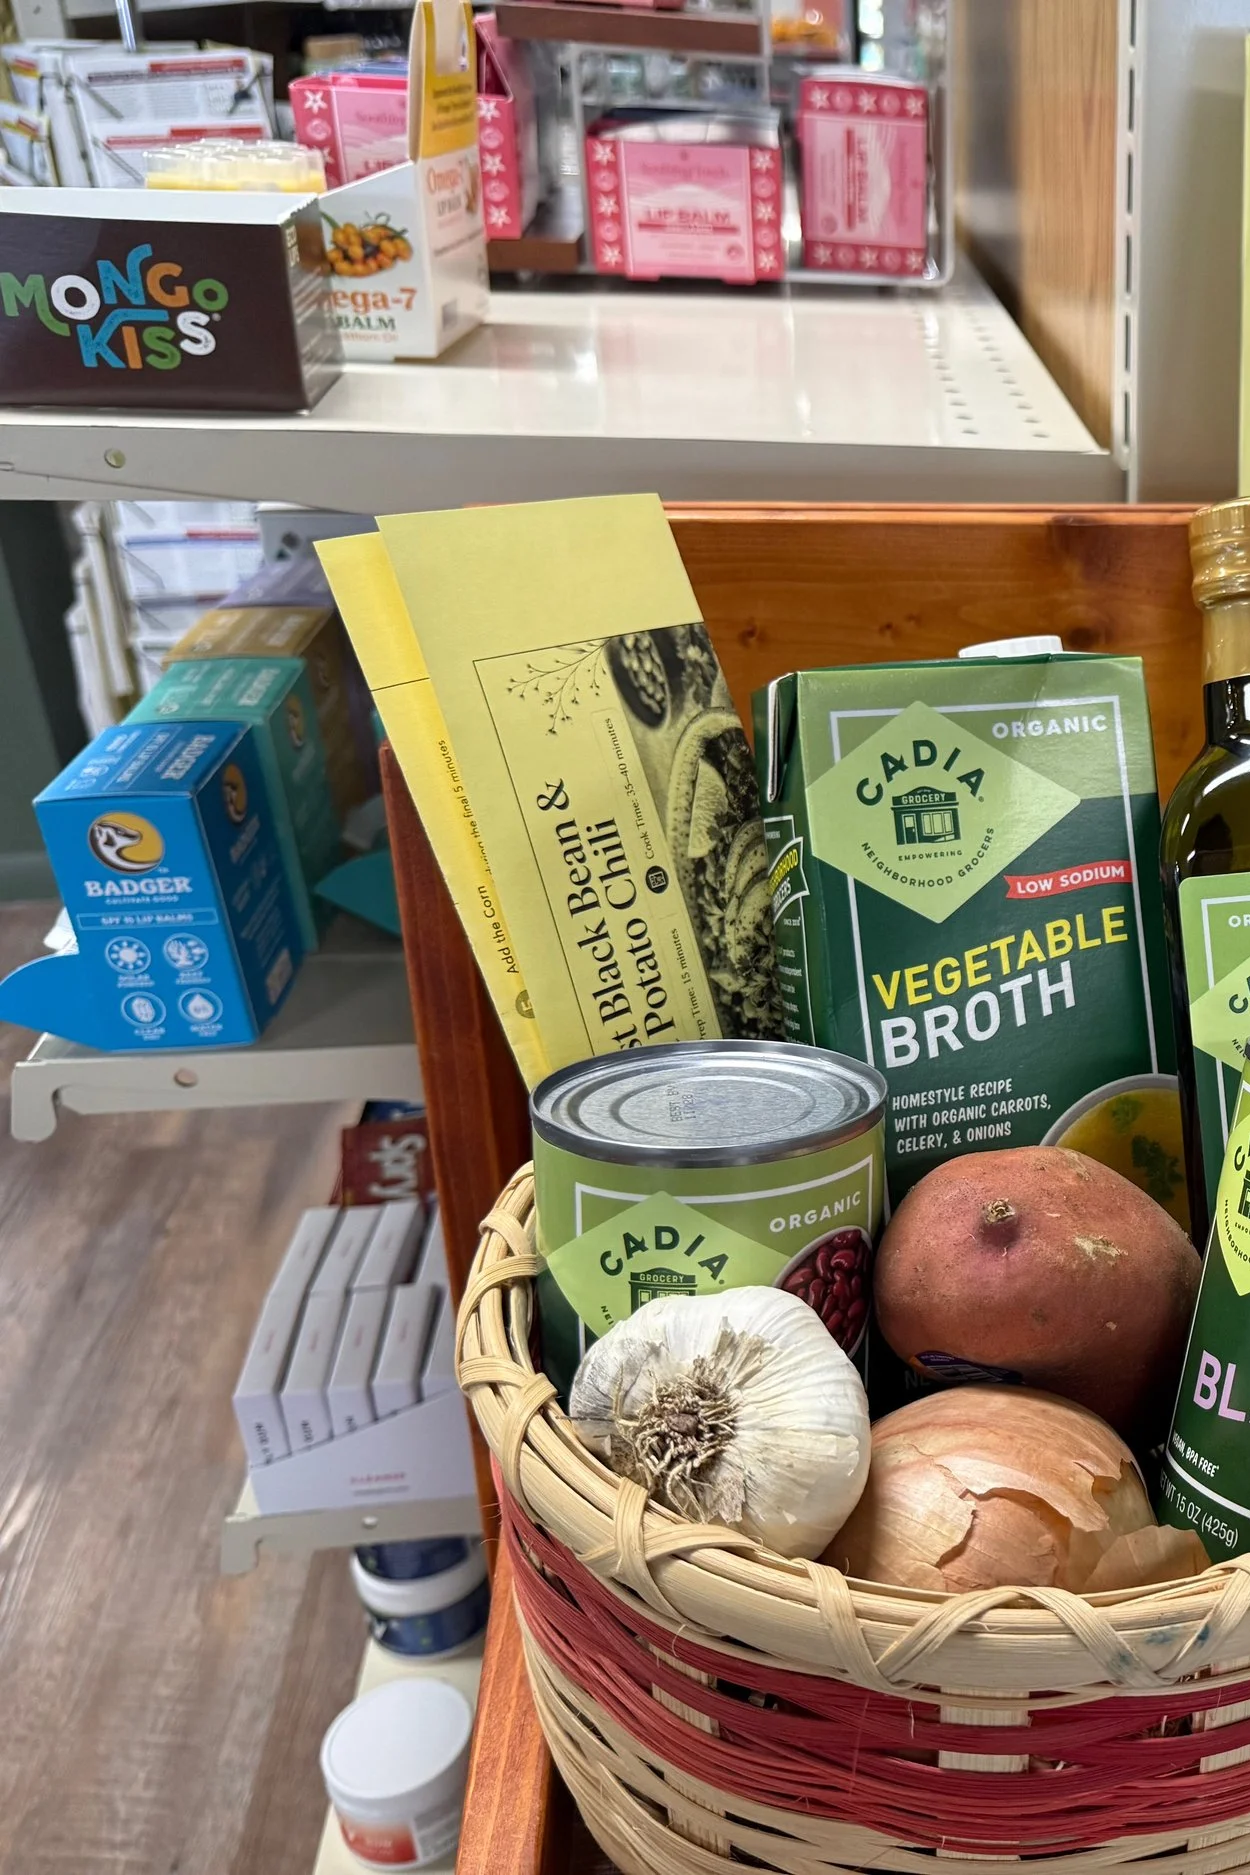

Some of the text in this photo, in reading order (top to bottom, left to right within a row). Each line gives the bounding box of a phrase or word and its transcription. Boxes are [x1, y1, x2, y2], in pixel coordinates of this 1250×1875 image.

[0, 243, 228, 337] MONGO
[76, 308, 217, 370] KISS
[603, 717, 626, 761] minutes
[992, 714, 1109, 740] ORGANIC
[438, 740, 478, 838] the final minutes
[856, 738, 986, 807] CADIA
[536, 777, 570, 812] &
[630, 797, 647, 831] Time:
[901, 792, 946, 806] GROCERY
[585, 816, 638, 910] Chili
[637, 833, 656, 860] Cook
[861, 841, 954, 888] NEIGHBORHOOD
[958, 826, 995, 879] GROCERS
[898, 849, 963, 862] EMPOWERING
[83, 876, 193, 898] BADGER
[555, 817, 602, 918] Bean
[1016, 864, 1125, 895] LOW SODIUM
[477, 885, 497, 919] Corn
[491, 921, 505, 944] the
[671, 927, 688, 968] minutes
[497, 947, 520, 975] Add
[577, 916, 633, 1026] Black
[681, 968, 693, 985] 15
[872, 905, 1128, 1011] VEGETABLE
[625, 917, 677, 1040] Potato
[880, 960, 1076, 1069] BROTH
[892, 1077, 1013, 1112] HOMESTYLE RECIPE
[894, 1093, 1052, 1133] WITH ORGANIC CARROTS,
[897, 1121, 1012, 1155] CELERY, & ONIONS
[769, 1190, 862, 1234] ORGANIC
[599, 1225, 730, 1281] CADIA
[639, 1271, 685, 1284] GROCERY
[1185, 1446, 1199, 1465] BPA
[1176, 1493, 1186, 1513] 15
[1187, 1501, 1202, 1526] OZ
[1202, 1512, 1240, 1550] (425g)
